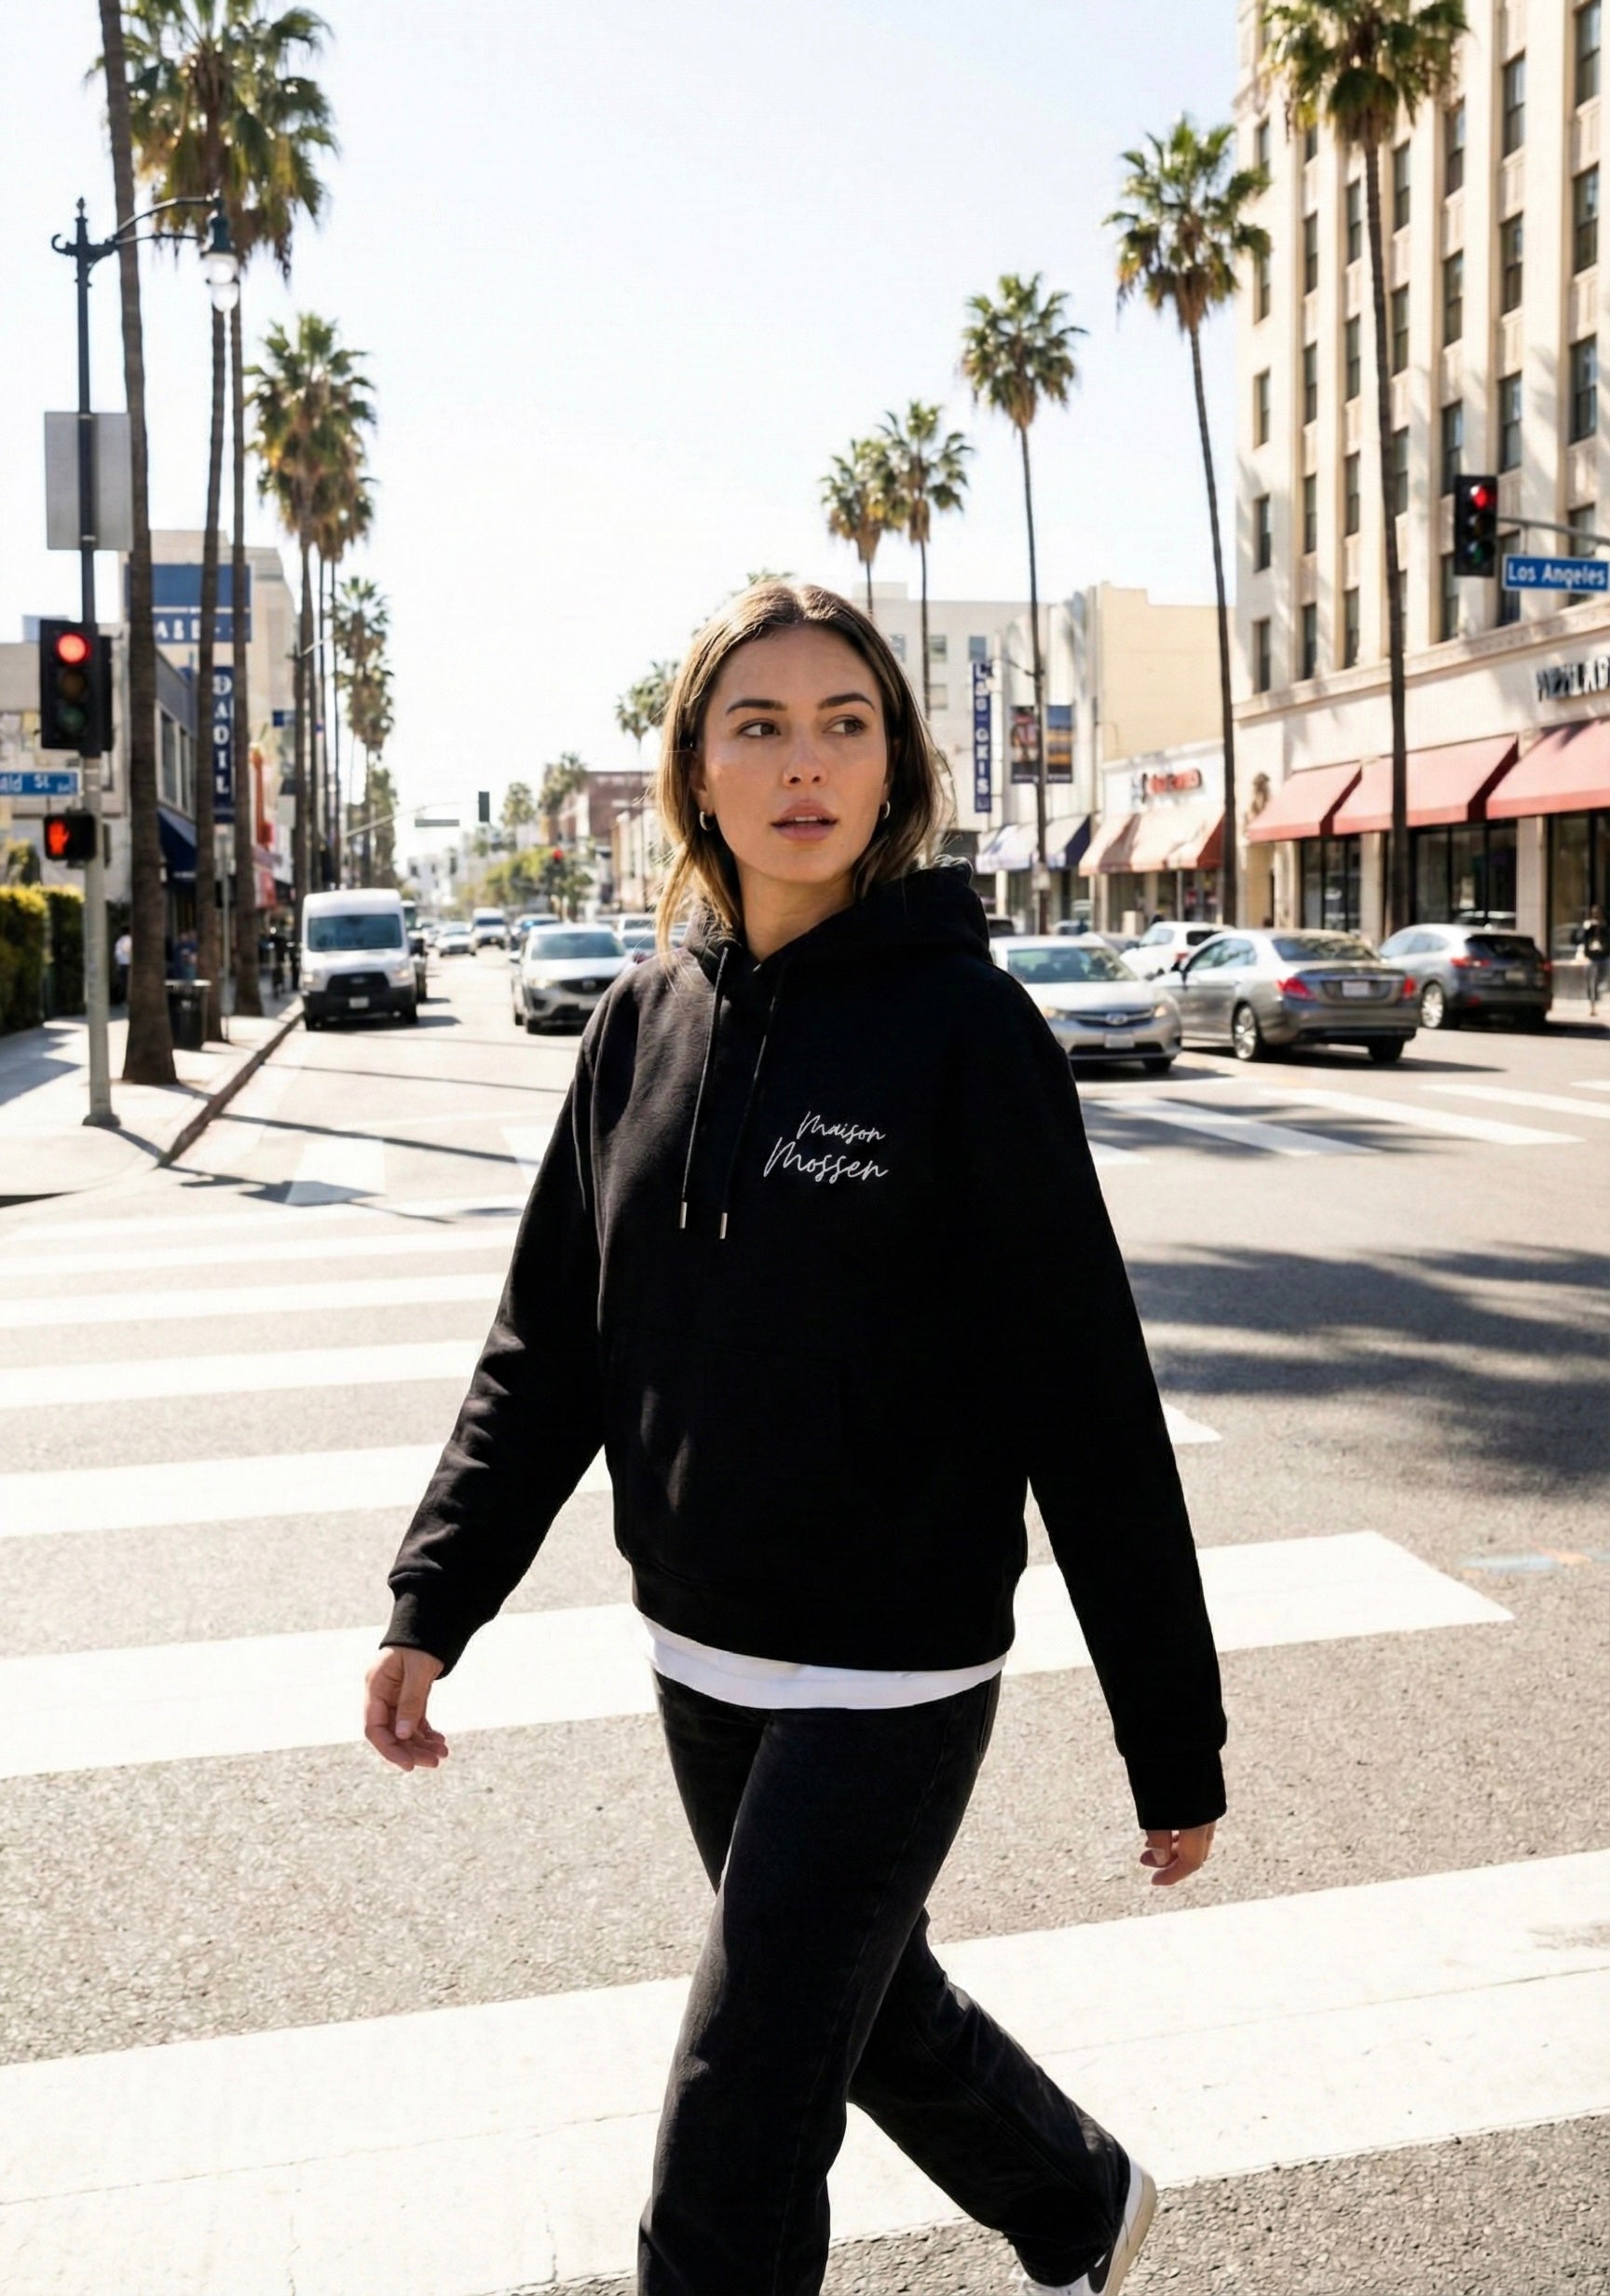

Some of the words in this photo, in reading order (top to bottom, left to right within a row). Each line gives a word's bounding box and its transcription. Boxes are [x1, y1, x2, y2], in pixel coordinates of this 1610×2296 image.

[1508, 562, 1536, 582] Los
[1541, 562, 1606, 590] Angeles
[797, 1112, 886, 1145] Maison
[763, 1136, 889, 1184] Mossen
